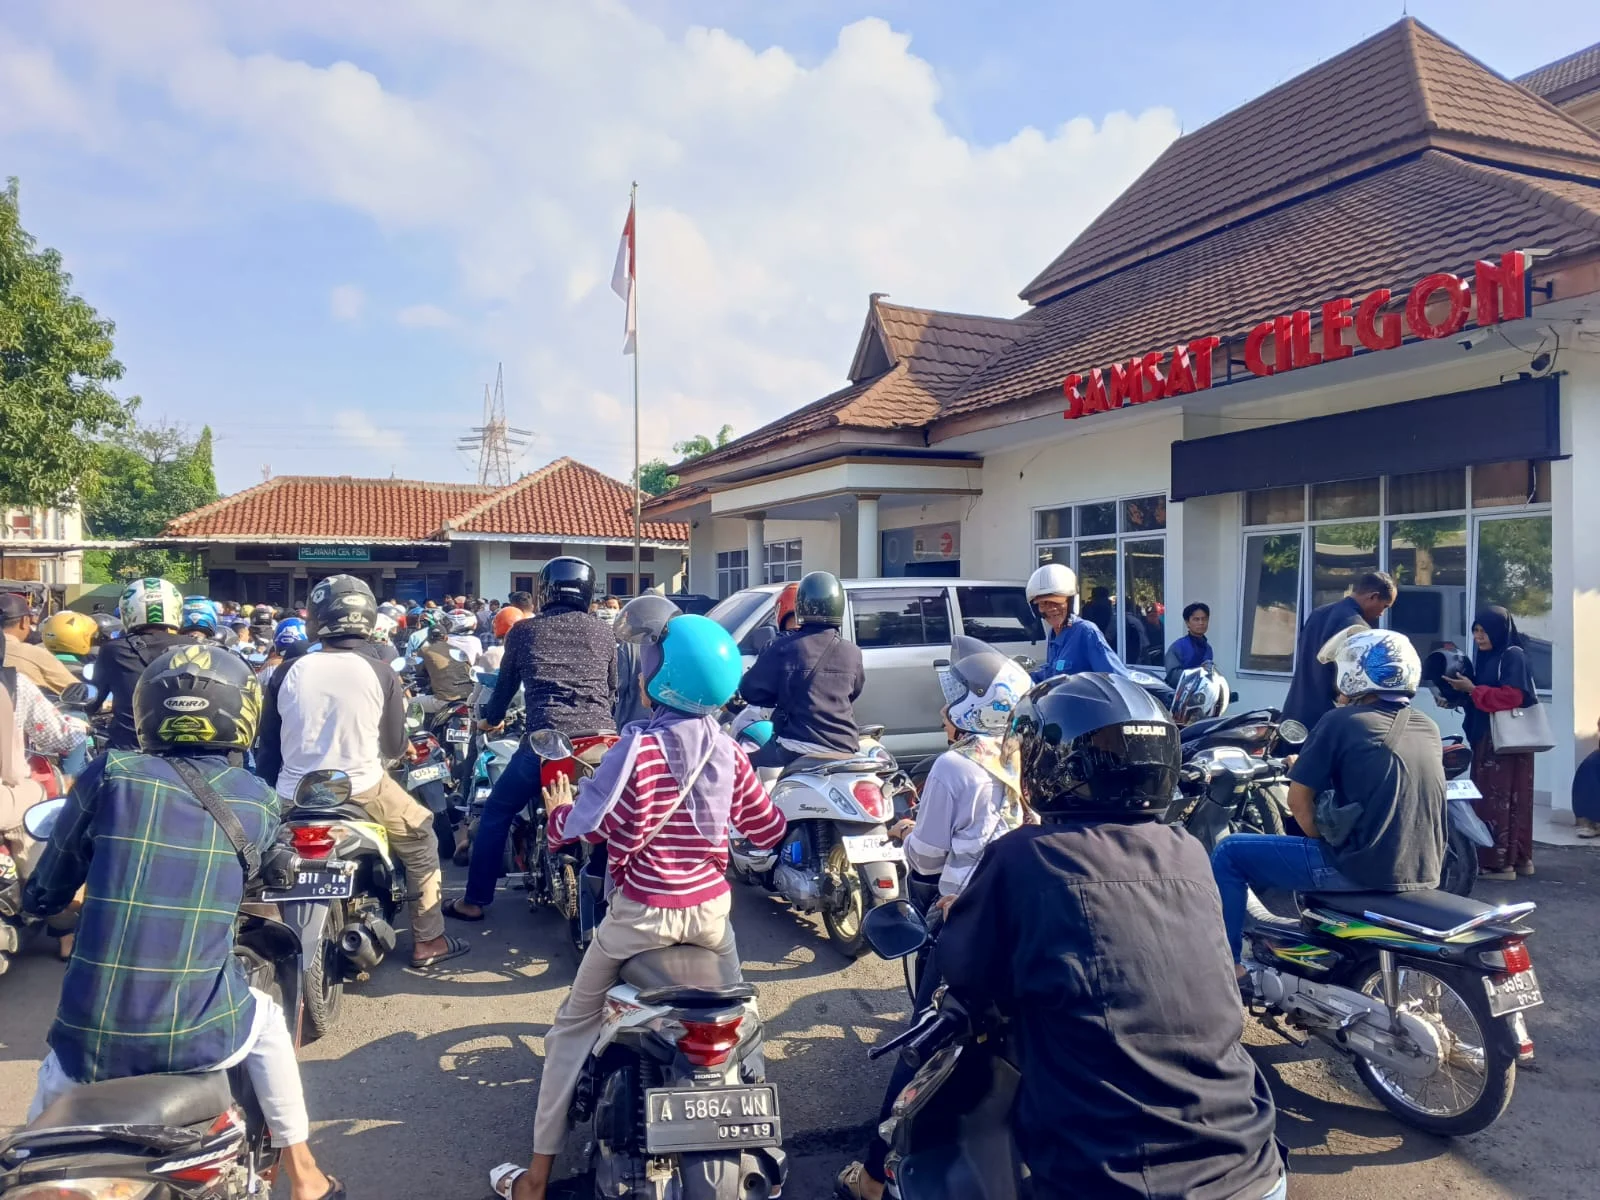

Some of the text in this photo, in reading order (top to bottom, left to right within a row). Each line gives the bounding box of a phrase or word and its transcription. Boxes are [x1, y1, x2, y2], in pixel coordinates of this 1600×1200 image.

[1064, 251, 1524, 419] SAMSAT CILEGON
[1123, 725, 1166, 736] SUZUKI
[694, 1072, 721, 1080] HONDA
[661, 1095, 768, 1121] A 5864 WN
